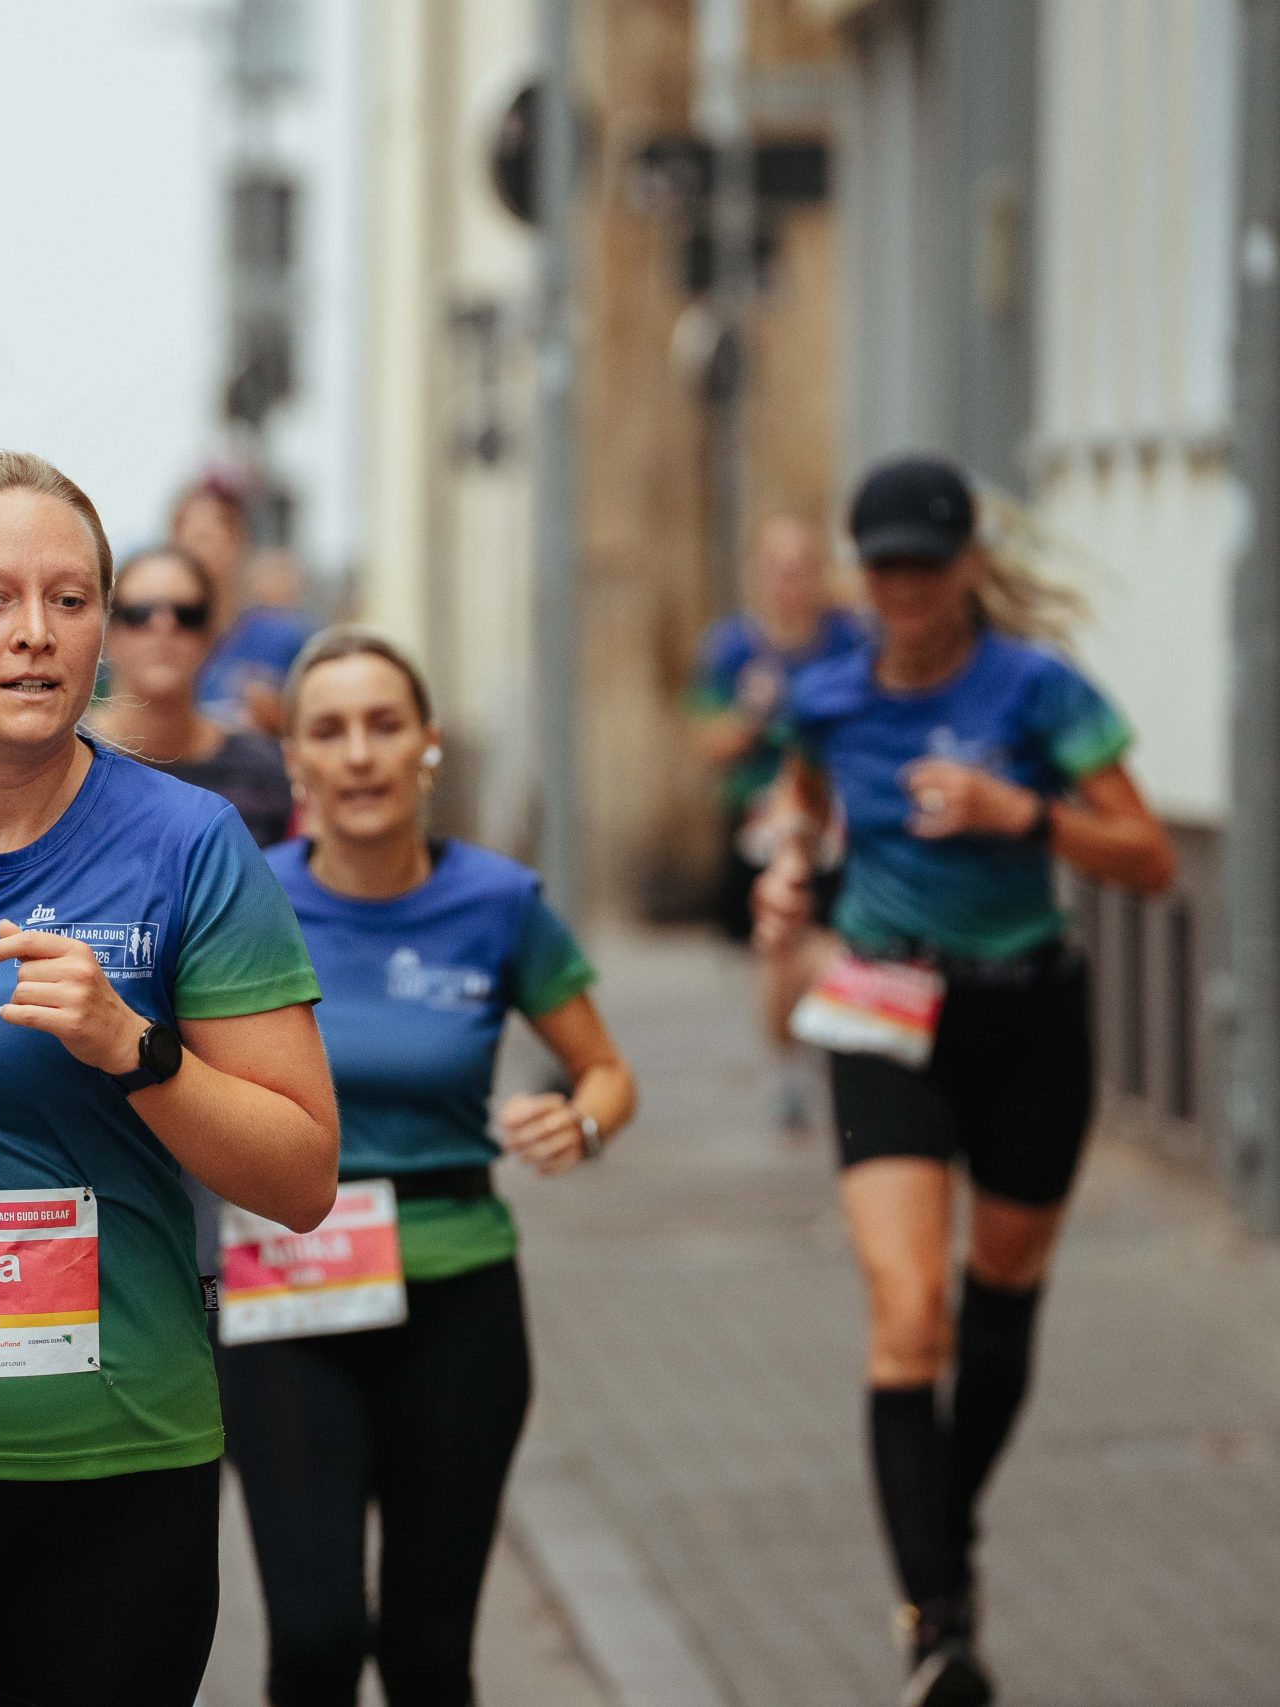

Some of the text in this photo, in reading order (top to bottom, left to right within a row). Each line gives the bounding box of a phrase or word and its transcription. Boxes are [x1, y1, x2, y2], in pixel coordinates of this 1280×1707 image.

[31, 904, 55, 919] dm
[75, 929, 125, 941] SAARLOUIS
[16, 1211, 39, 1221] GUDD
[40, 1209, 70, 1220] GELAAF
